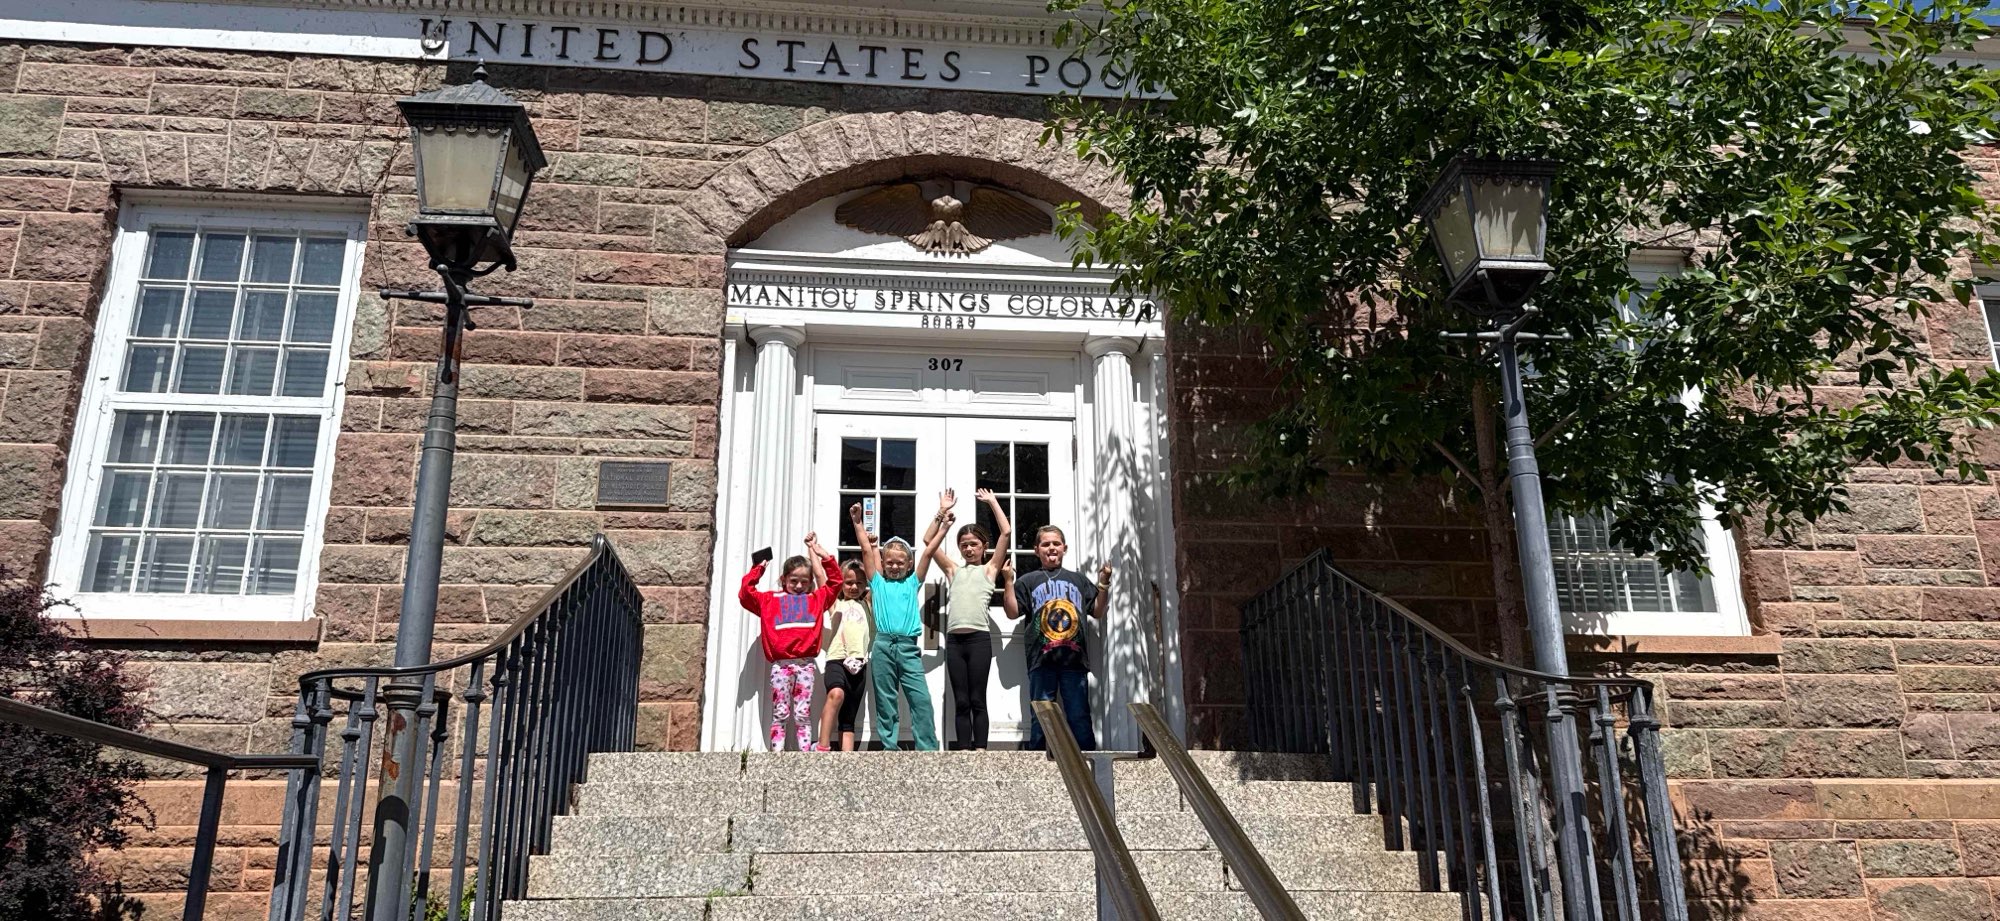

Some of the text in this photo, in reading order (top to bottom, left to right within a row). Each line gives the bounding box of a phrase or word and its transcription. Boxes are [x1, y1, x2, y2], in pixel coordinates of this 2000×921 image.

[419, 18, 673, 66] UNITED
[739, 37, 961, 82] STATES
[731, 284, 1158, 322] MANITOU SPRINGS COLORADO
[928, 357, 963, 371] 307
